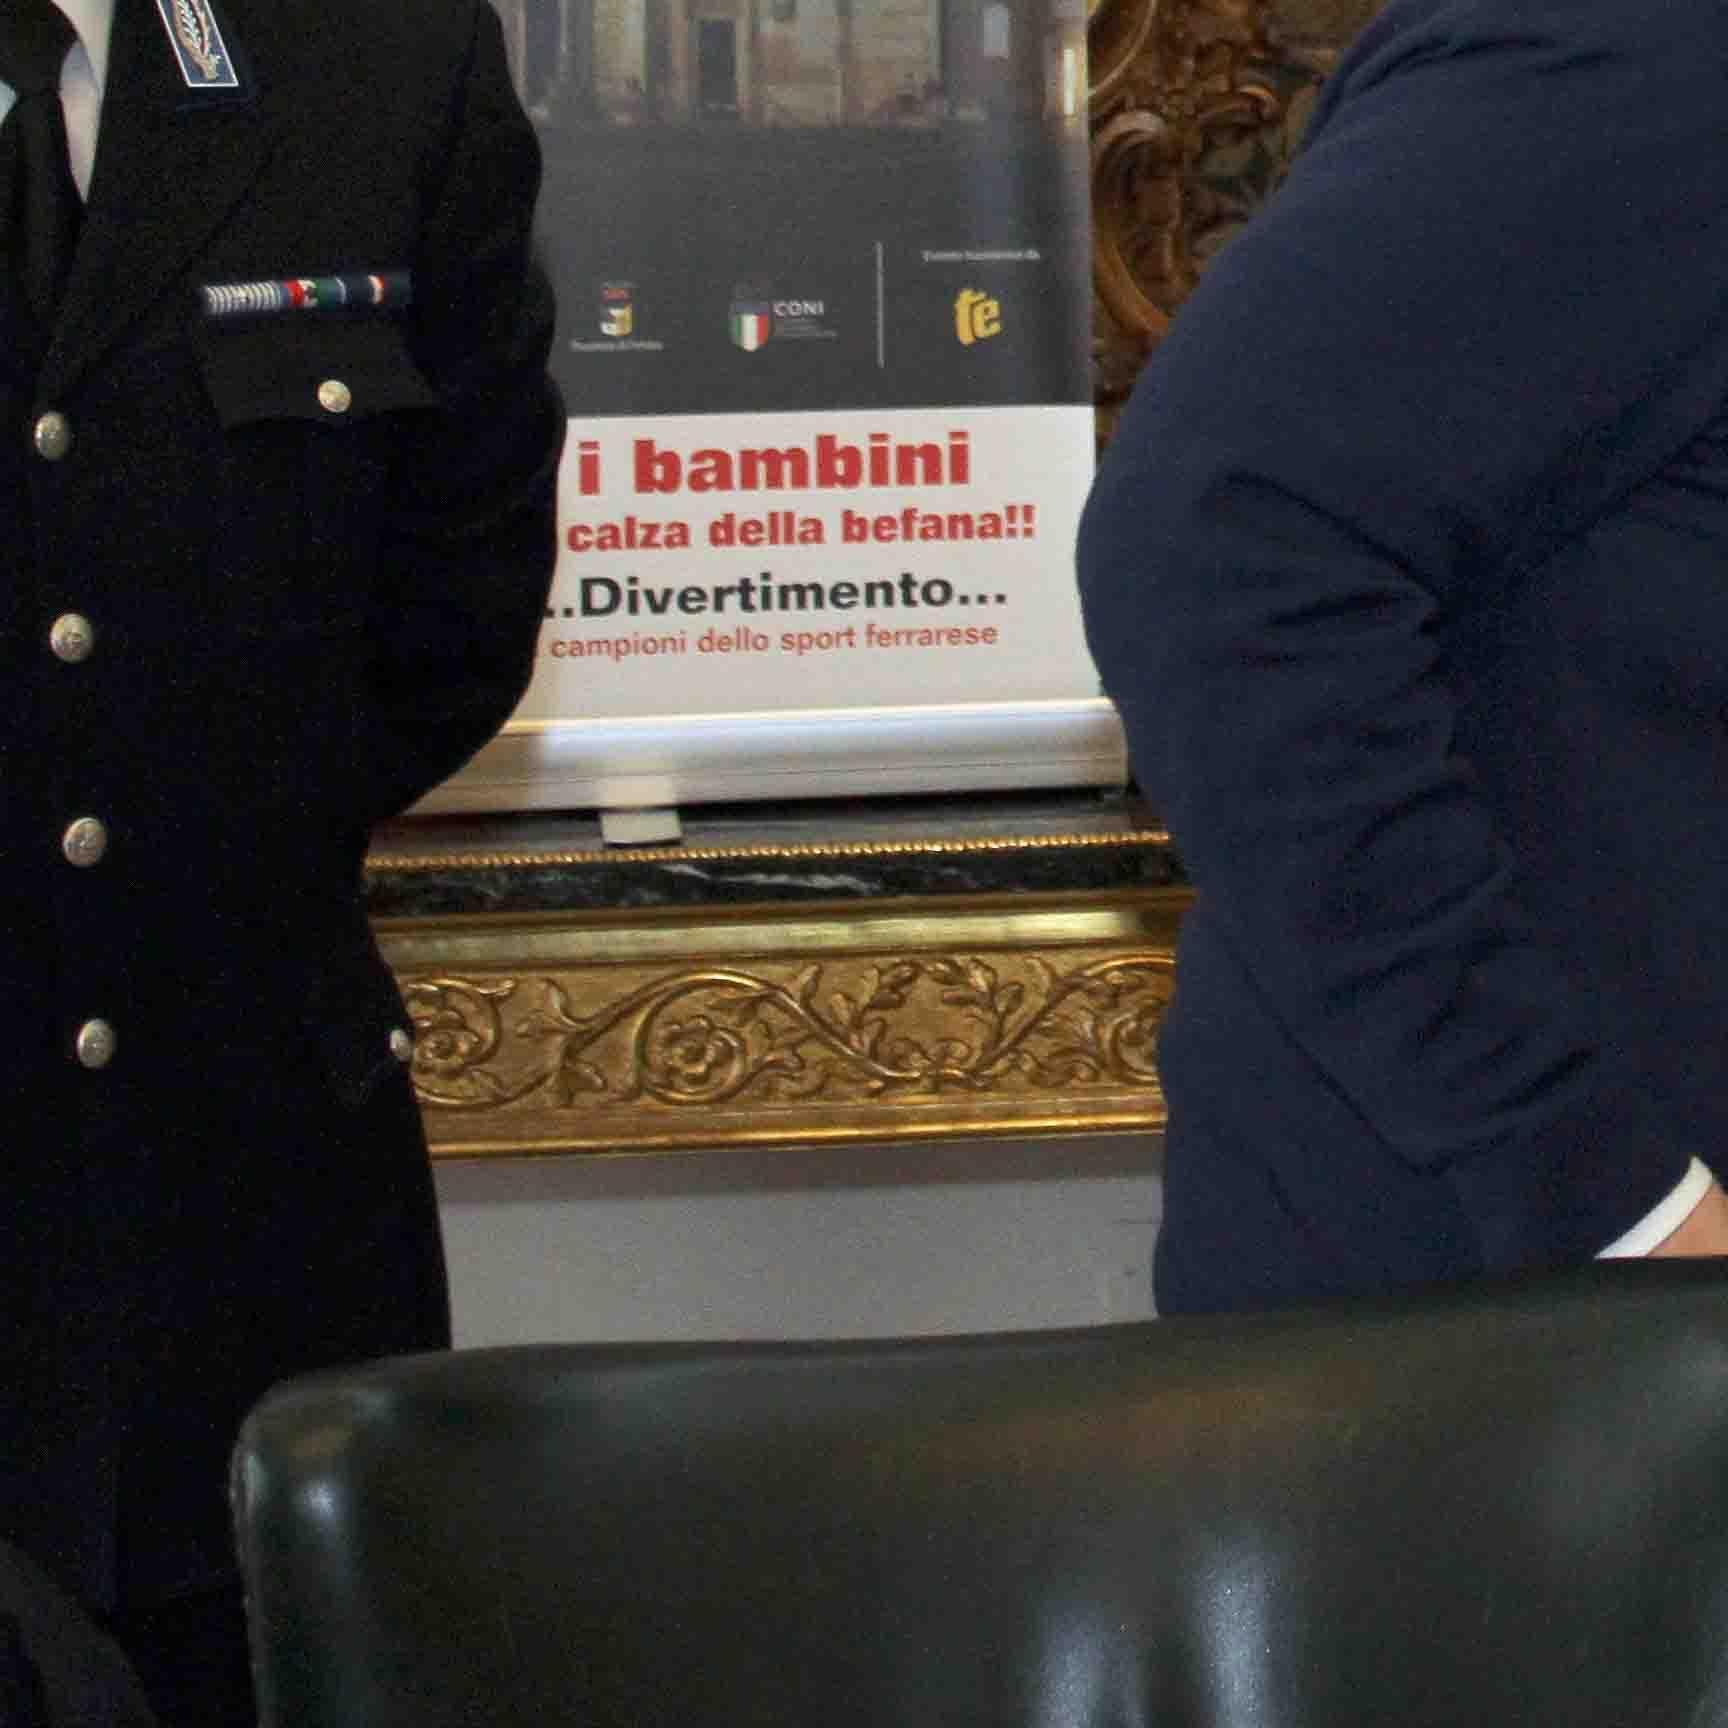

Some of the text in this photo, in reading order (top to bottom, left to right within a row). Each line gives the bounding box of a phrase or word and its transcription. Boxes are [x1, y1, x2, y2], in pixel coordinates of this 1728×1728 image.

[772, 300, 825, 317] CONI
[578, 431, 969, 495] i bambini
[567, 504, 1036, 553] calza della befana!!
[551, 623, 998, 663] campioni dello sport ferrarese
